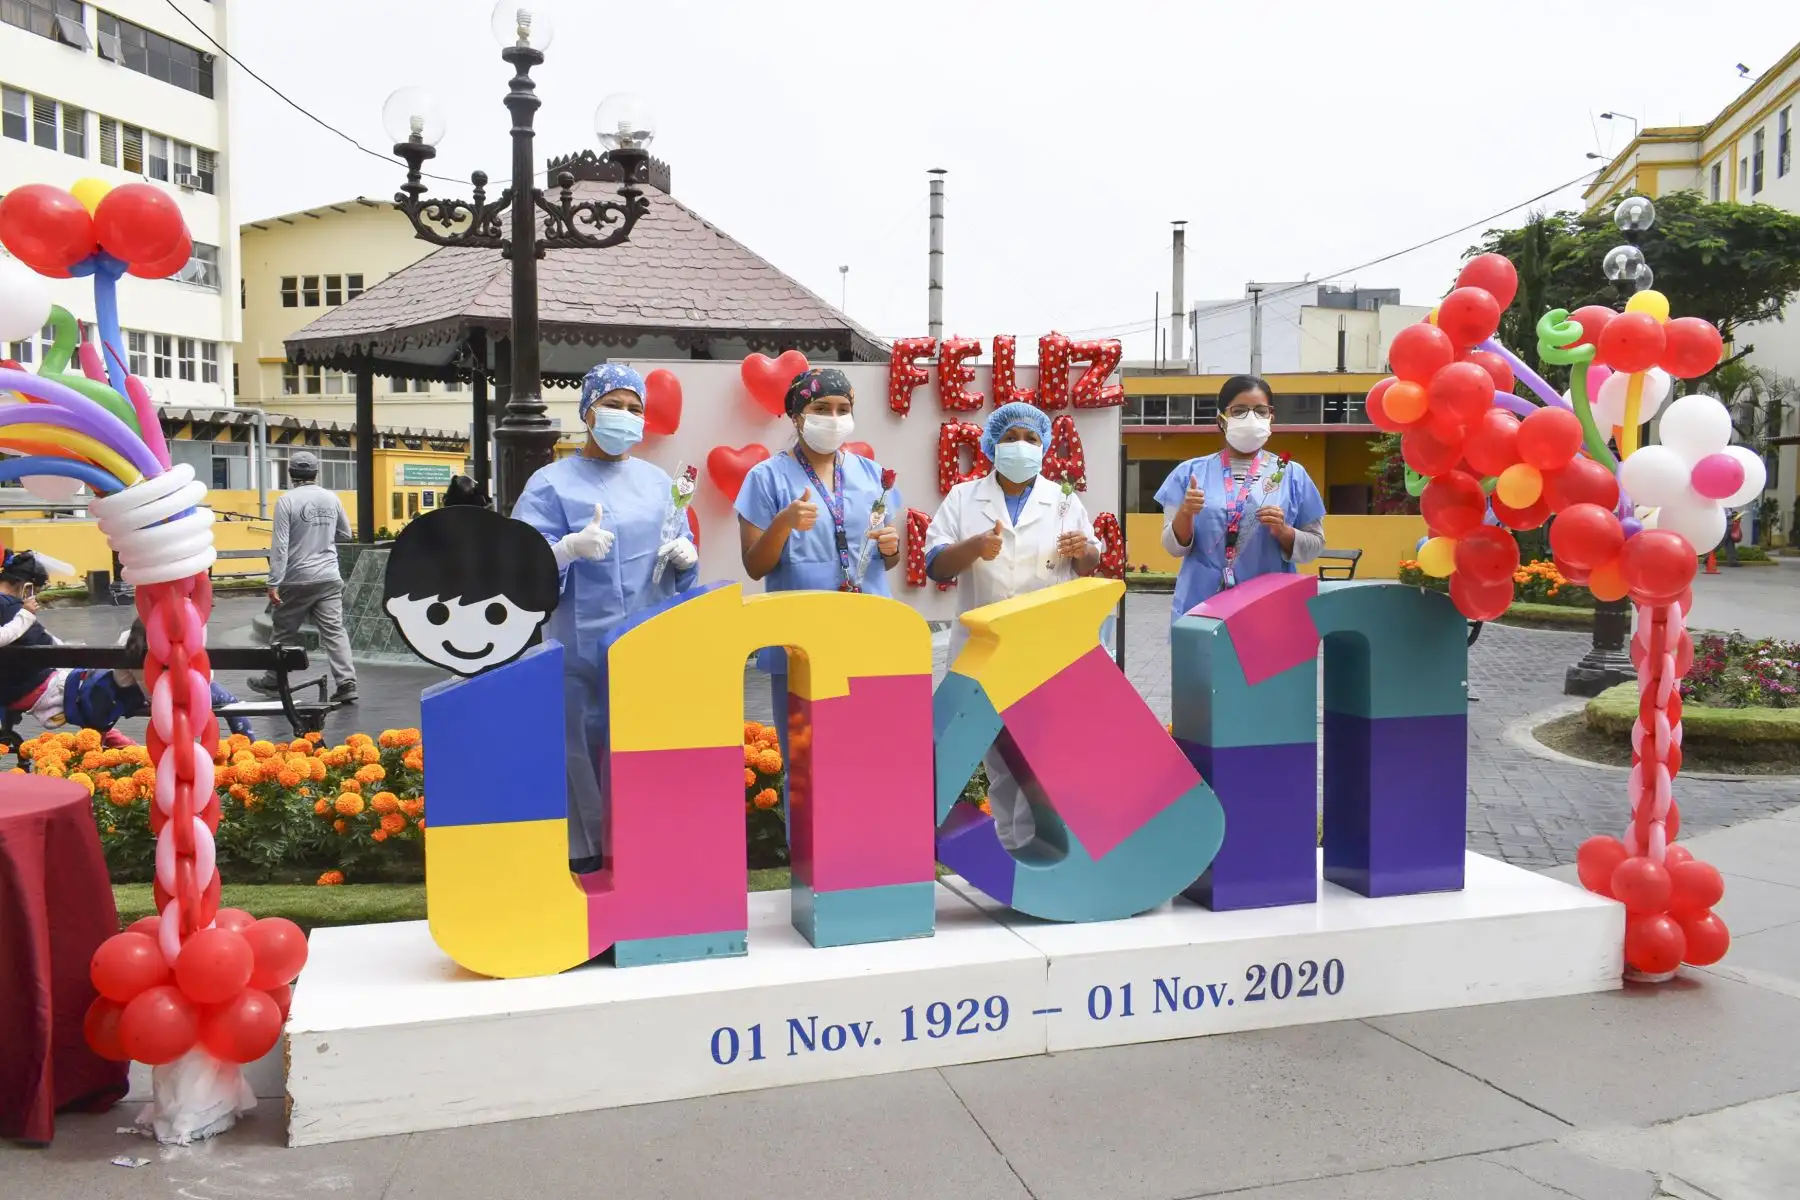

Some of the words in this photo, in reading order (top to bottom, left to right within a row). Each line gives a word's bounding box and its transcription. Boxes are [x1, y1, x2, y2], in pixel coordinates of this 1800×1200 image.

[888, 329, 1125, 417] FELIZ
[938, 415, 1087, 496] DA
[711, 1023, 766, 1065] 01
[786, 1015, 882, 1057] Nov.
[901, 994, 1010, 1042] 1929
[1087, 982, 1135, 1021] 01
[1152, 976, 1234, 1014] Nov.
[1244, 958, 1345, 1002] 2020
